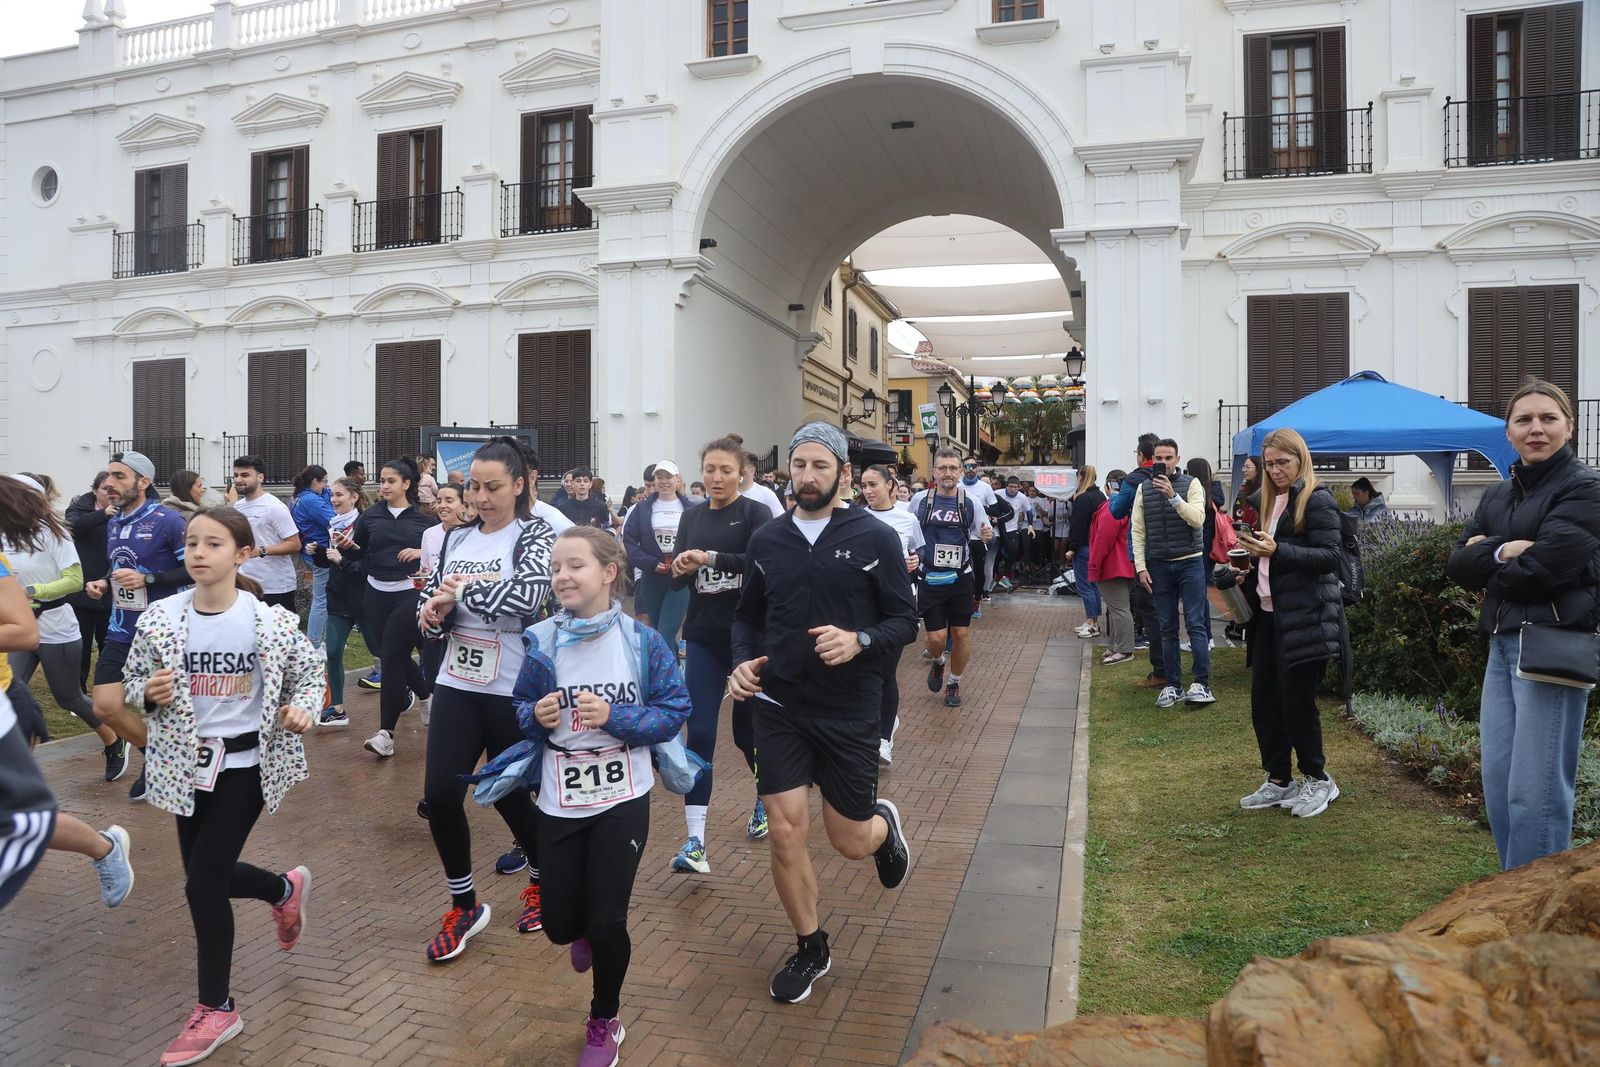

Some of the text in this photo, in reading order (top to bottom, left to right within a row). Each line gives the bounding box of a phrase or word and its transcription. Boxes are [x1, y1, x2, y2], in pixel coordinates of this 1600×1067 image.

[937, 549, 960, 560] 311
[118, 587, 135, 600] 46
[457, 645, 484, 668] 35
[563, 760, 625, 790] 218
